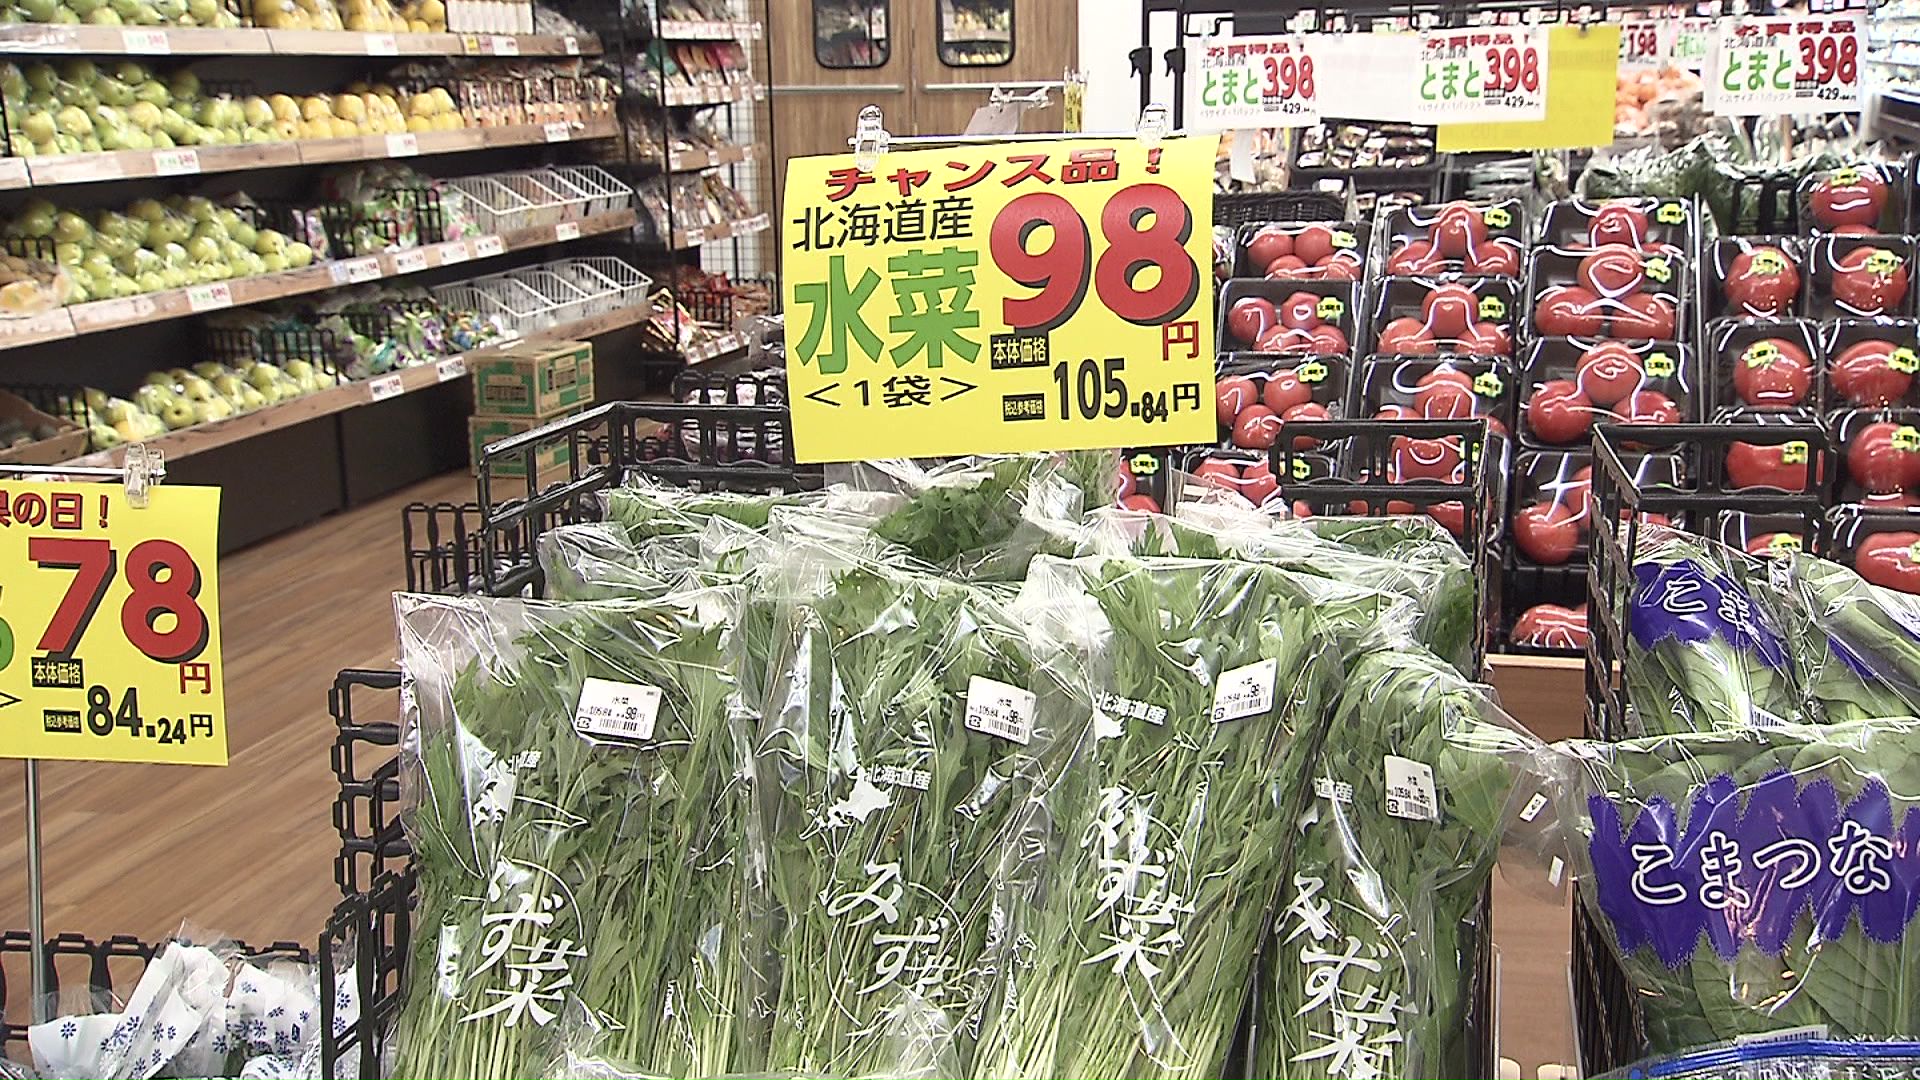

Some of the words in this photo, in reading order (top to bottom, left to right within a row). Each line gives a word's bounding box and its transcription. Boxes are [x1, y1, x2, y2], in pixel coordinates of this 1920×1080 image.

[1628, 32, 1657, 56] 198
[1724, 35, 1777, 49] 北海道産
[1796, 35, 1858, 84] 398
[1202, 67, 1258, 107] とまと
[1262, 55, 1314, 99] 398
[1421, 61, 1480, 100] とまと
[1483, 48, 1539, 92] 398
[1724, 50, 1792, 90] とまと
[792, 195, 975, 252] 北海道産
[989, 183, 1200, 332] 98
[1162, 321, 1201, 361] 円
[794, 246, 982, 375] 水菜
[993, 337, 1048, 363] 本体価格
[28, 537, 210, 664] 78
[179, 662, 211, 694] 円
[33, 661, 81, 684] 本体価格
[1095, 691, 1168, 726] 北海道産
[866, 766, 932, 791] 北海道産
[1314, 777, 1353, 803] 道産
[1630, 819, 1893, 911] こまつな
